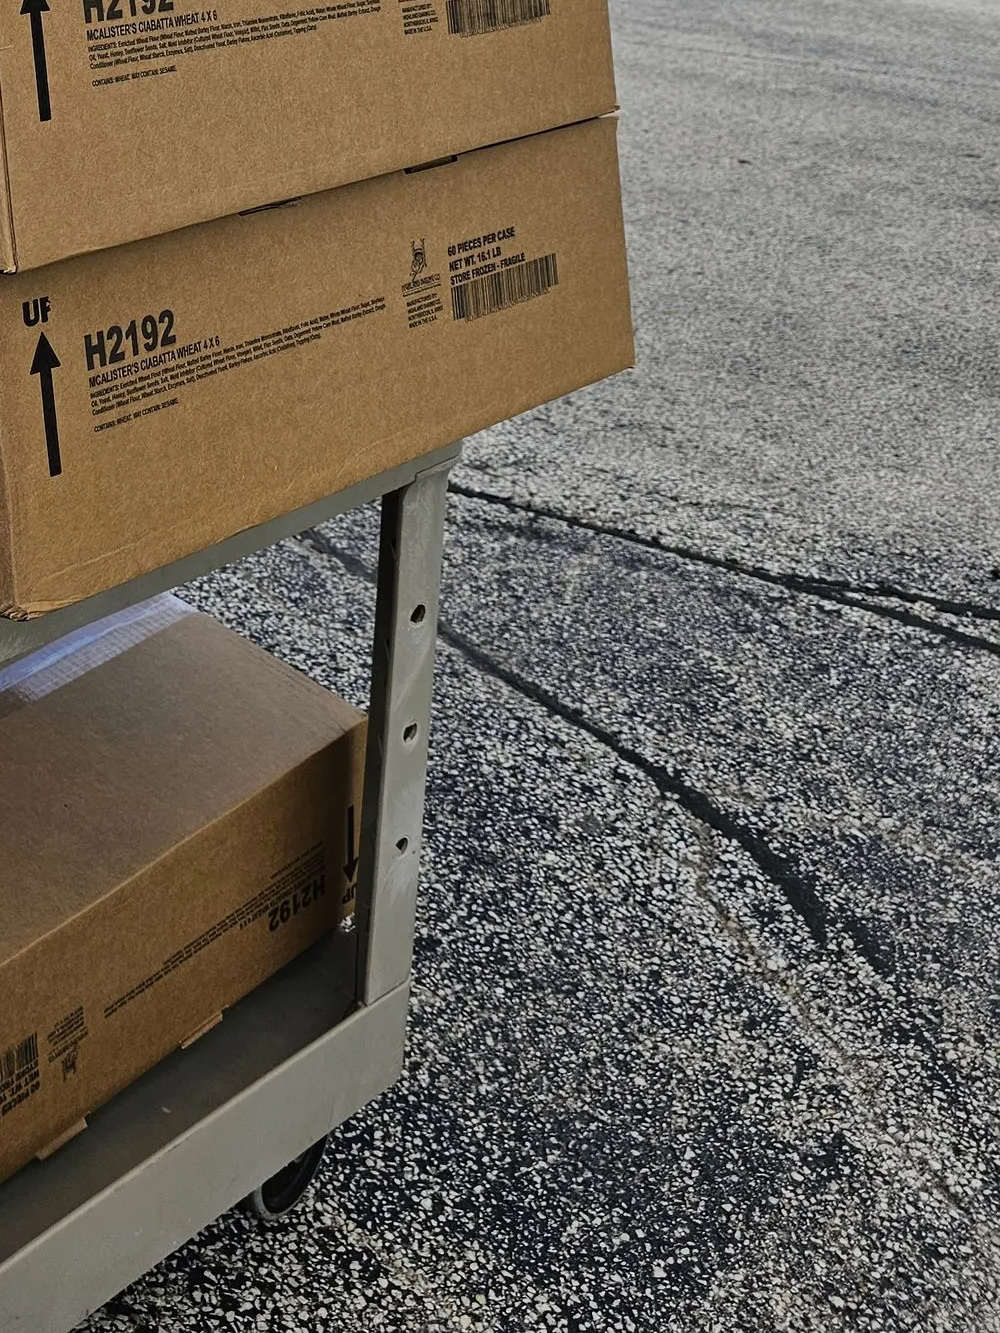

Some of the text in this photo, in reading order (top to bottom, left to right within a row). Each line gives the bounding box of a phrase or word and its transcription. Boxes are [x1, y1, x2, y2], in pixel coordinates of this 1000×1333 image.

[87, 23, 137, 41] MCALISTER'S
[138, 17, 174, 33] CIABATTA
[174, 12, 199, 27] WHEAT
[206, 10, 213, 22] X
[212, 10, 218, 21] 6
[447, 226, 515, 257] 60 PIECES PER CASE
[449, 246, 502, 272] NET WT. 16.1 LB
[450, 270, 471, 286] STORE
[472, 262, 496, 278] FROZEN
[500, 252, 525, 269] FRAGILE
[83, 307, 177, 371] H2192
[89, 362, 139, 387] MCALISTER'S
[140, 350, 176, 371] CIABATTA
[176, 341, 202, 359] WHEAT
[209, 337, 215, 349] X
[215, 335, 220, 347] 6
[268, 874, 326, 932] H2192
